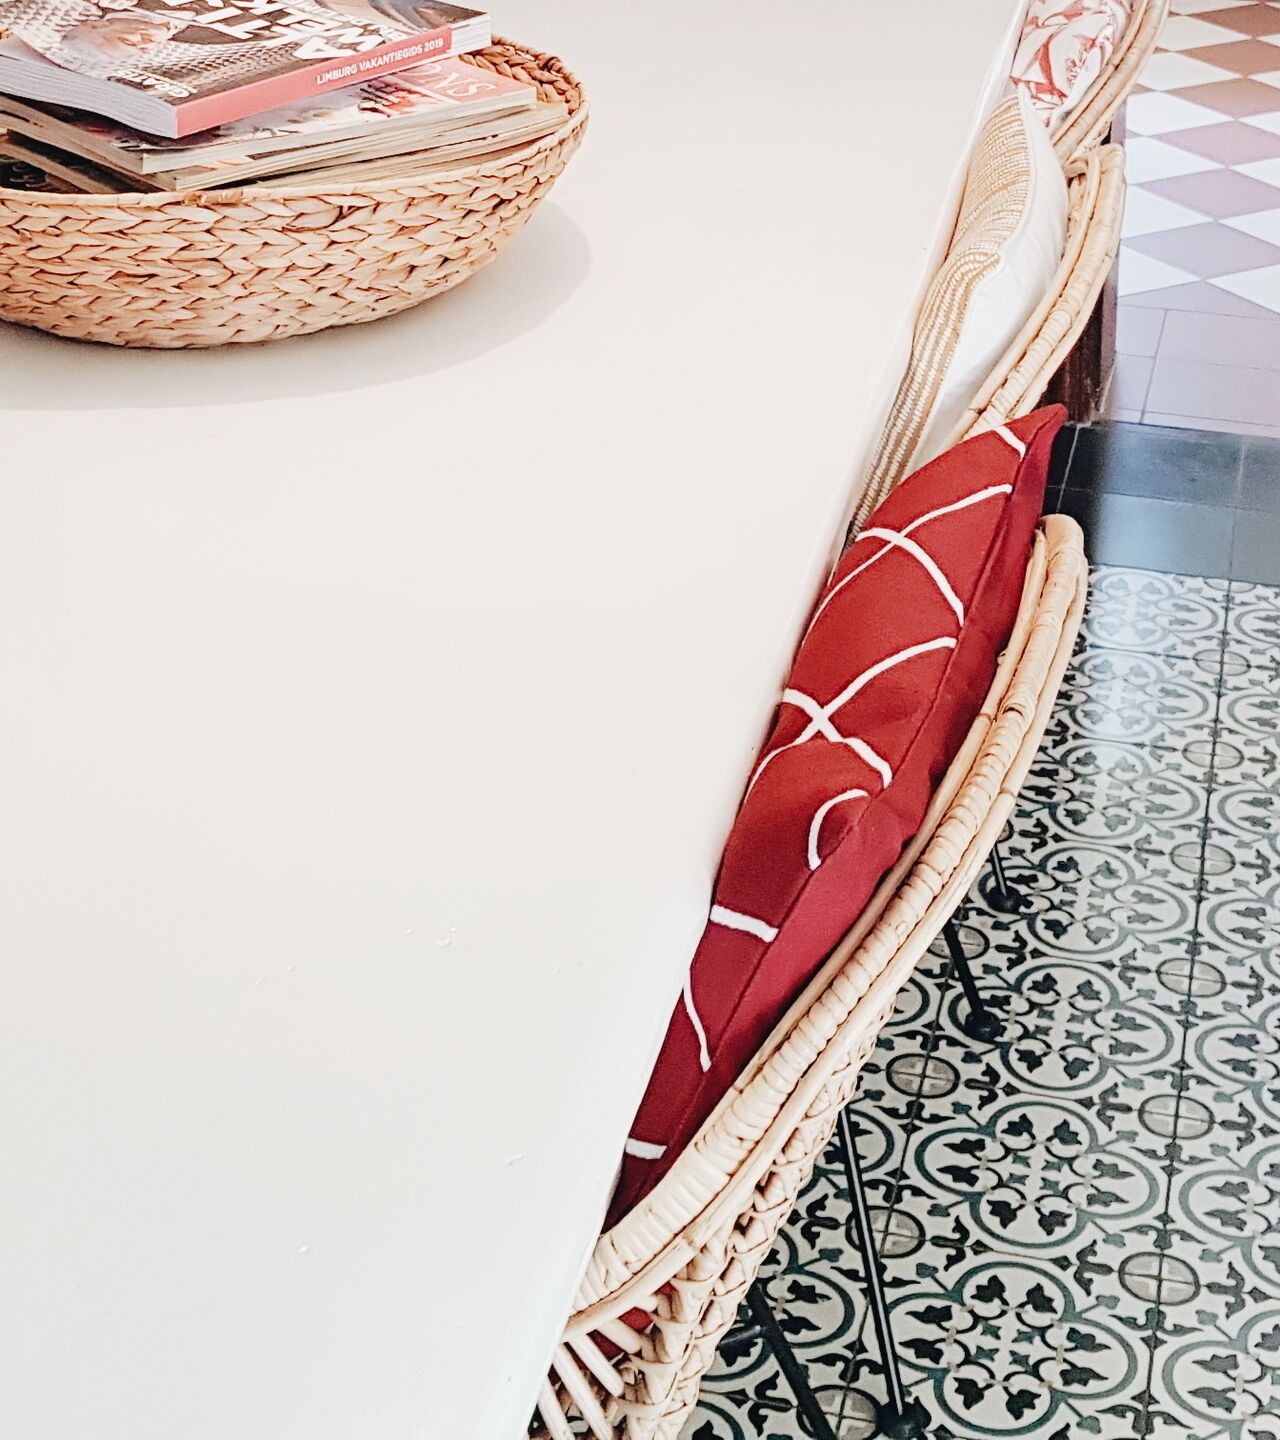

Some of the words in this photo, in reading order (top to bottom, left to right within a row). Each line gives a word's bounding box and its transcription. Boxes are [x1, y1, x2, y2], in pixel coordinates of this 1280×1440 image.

[315, 64, 357, 84] LIMBURG
[359, 44, 423, 74] VAKANTIEGIDS
[115, 69, 189, 97] GRATIS
